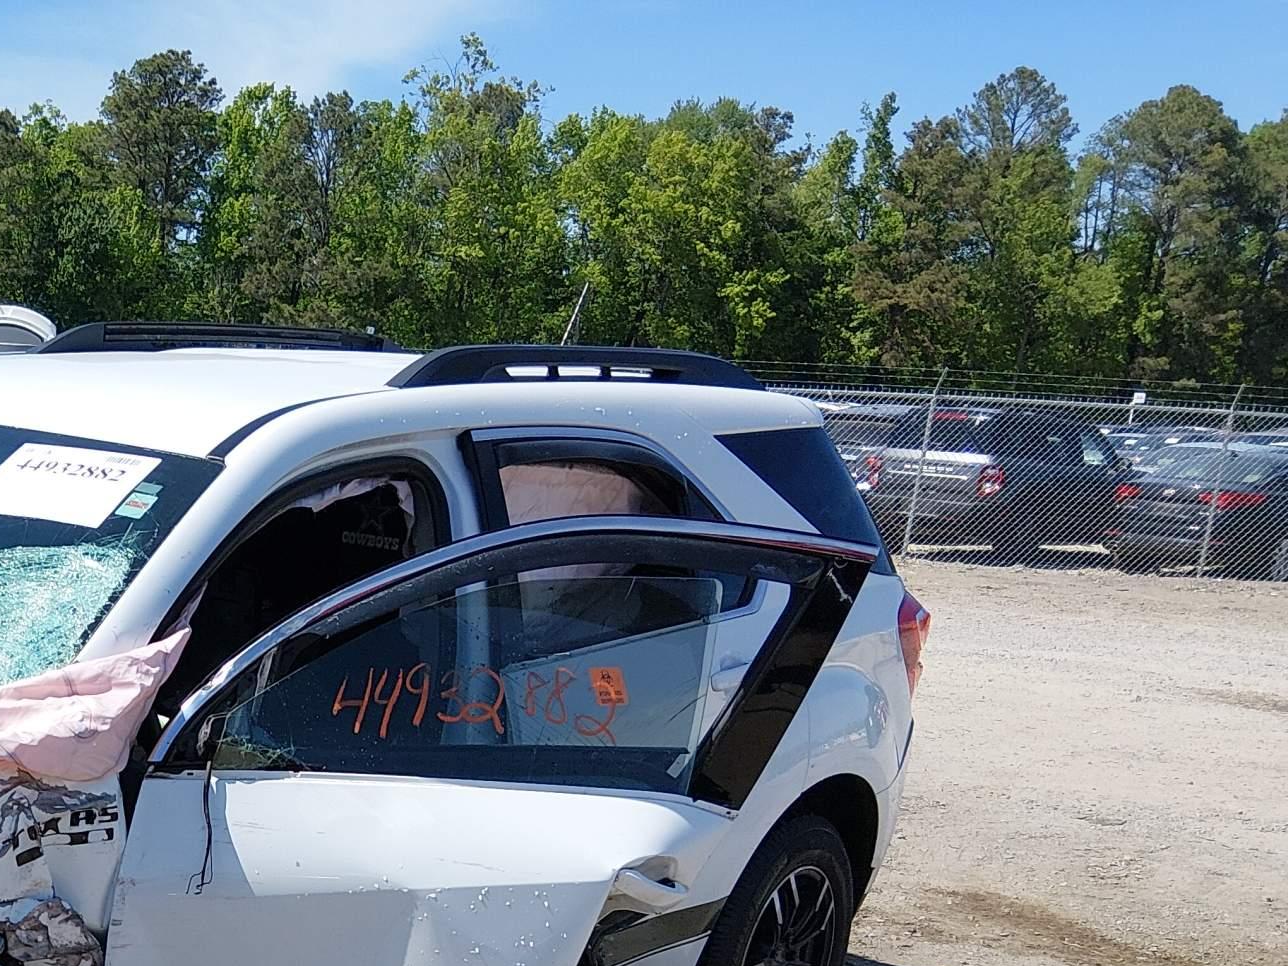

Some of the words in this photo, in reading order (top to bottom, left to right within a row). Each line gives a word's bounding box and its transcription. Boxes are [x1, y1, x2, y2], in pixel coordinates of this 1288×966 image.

[16, 458, 127, 482] 44932882
[342, 530, 400, 552] COWBOYS
[331, 662, 618, 746] 44932882
